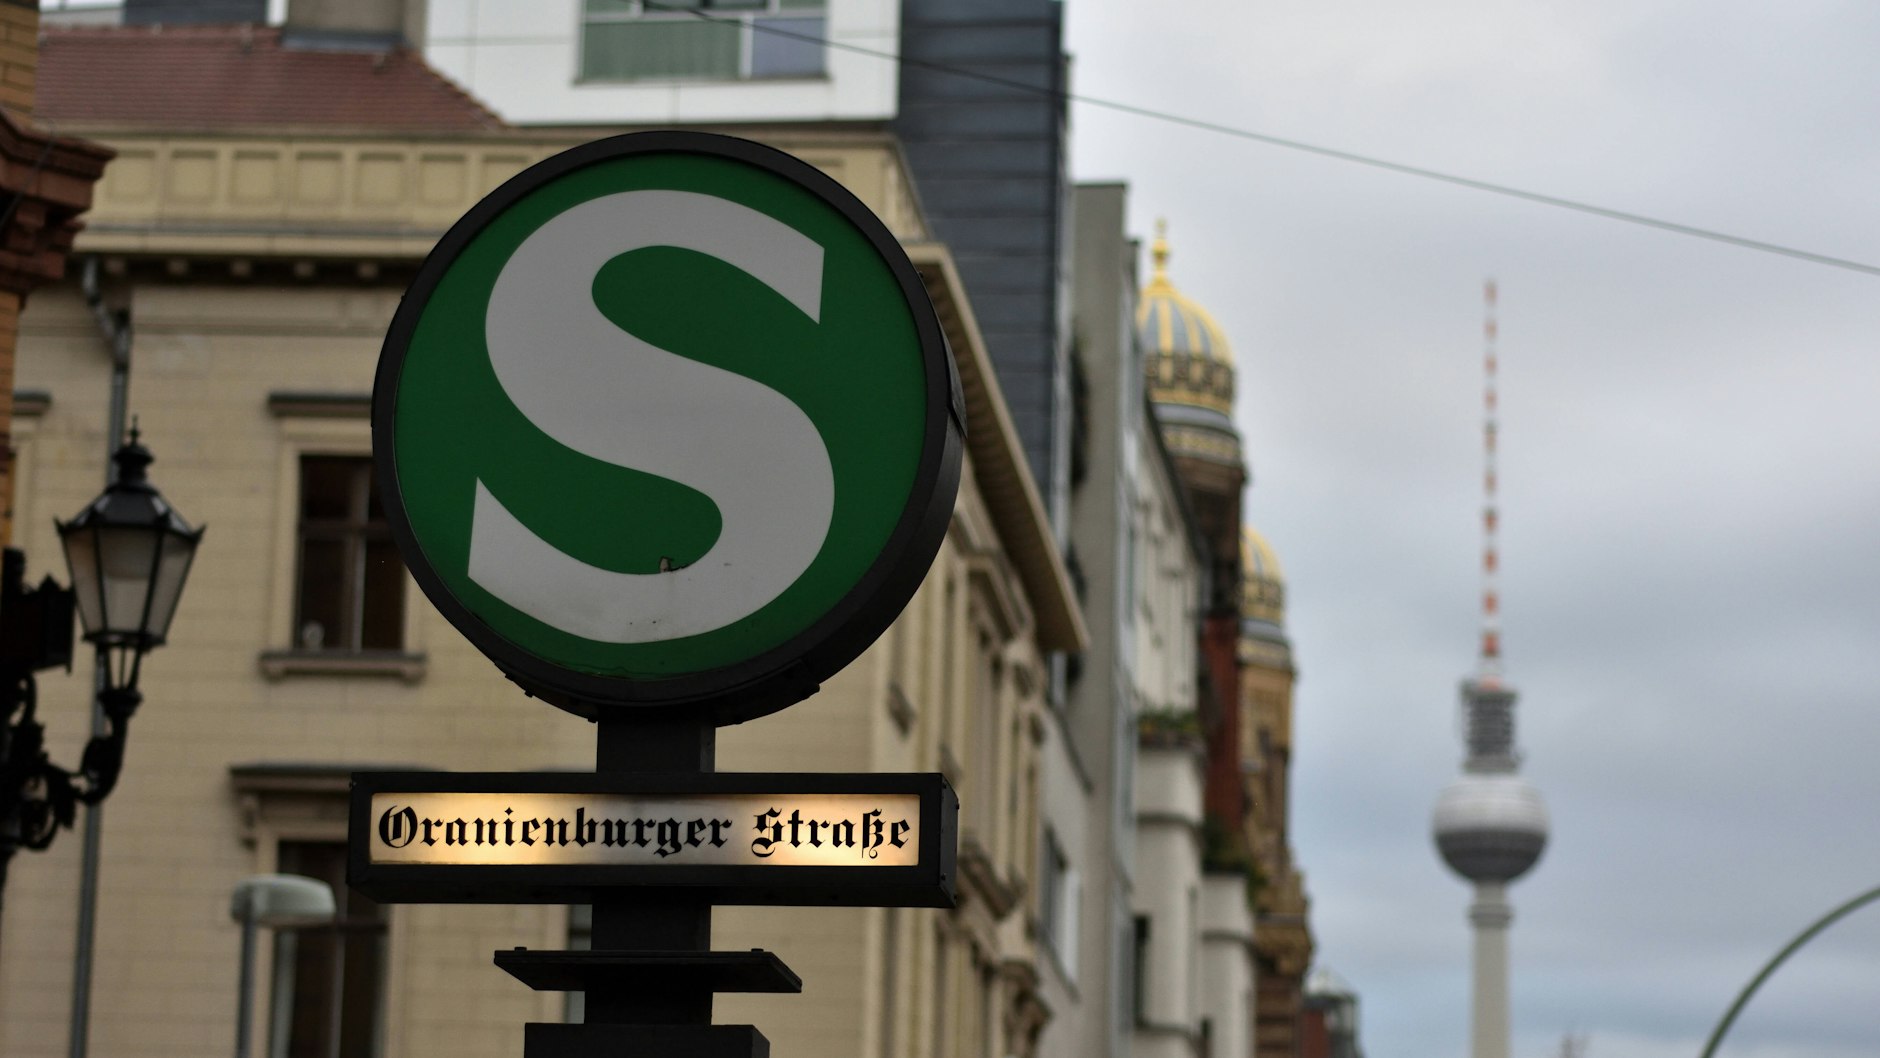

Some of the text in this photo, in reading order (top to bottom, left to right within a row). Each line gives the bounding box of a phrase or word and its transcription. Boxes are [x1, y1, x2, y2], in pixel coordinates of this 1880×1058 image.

[468, 189, 835, 644] S
[378, 805, 911, 859] Oranienburger Straße
